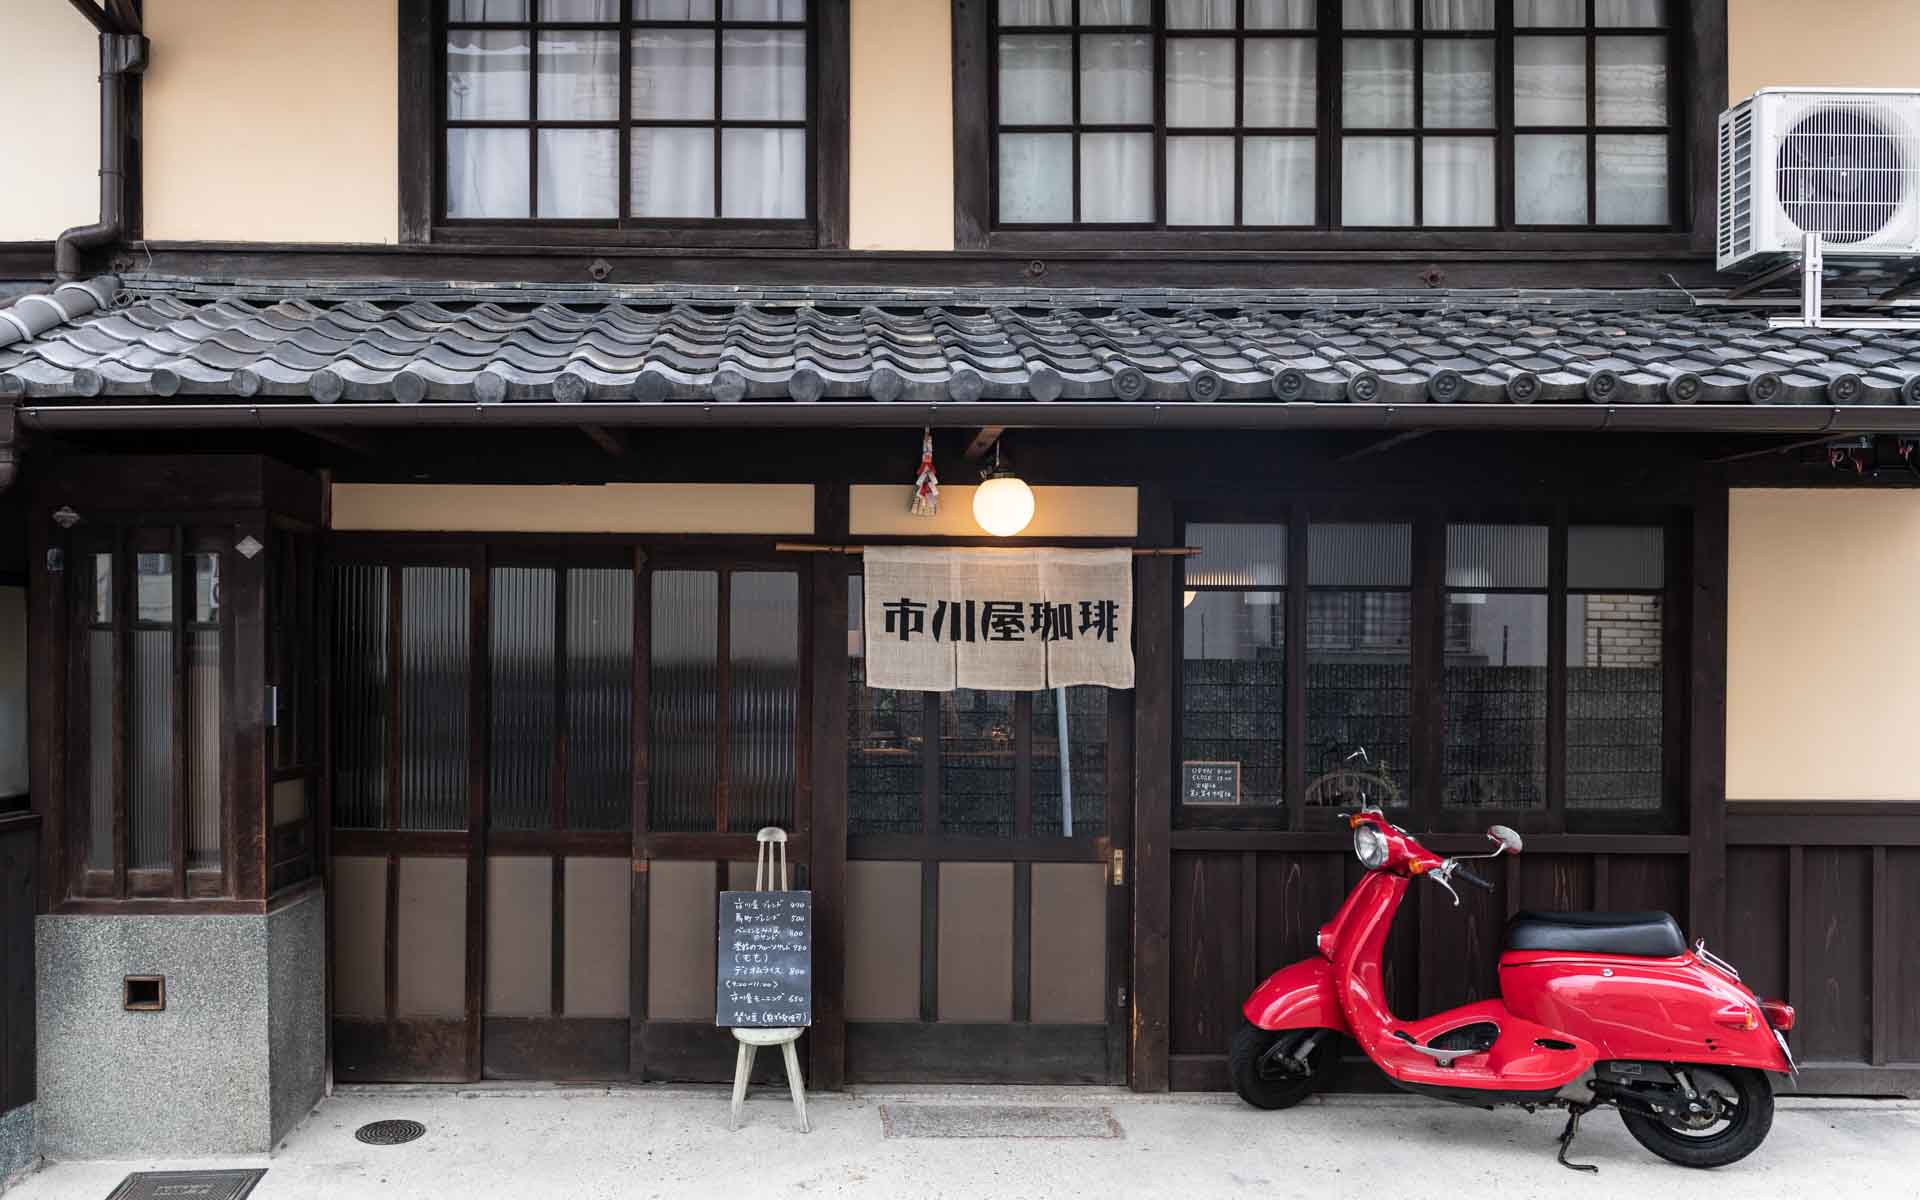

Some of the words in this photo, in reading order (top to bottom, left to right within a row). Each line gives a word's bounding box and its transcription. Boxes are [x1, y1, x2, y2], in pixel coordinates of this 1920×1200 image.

[882, 597, 1119, 643] 市川屋珈琲
